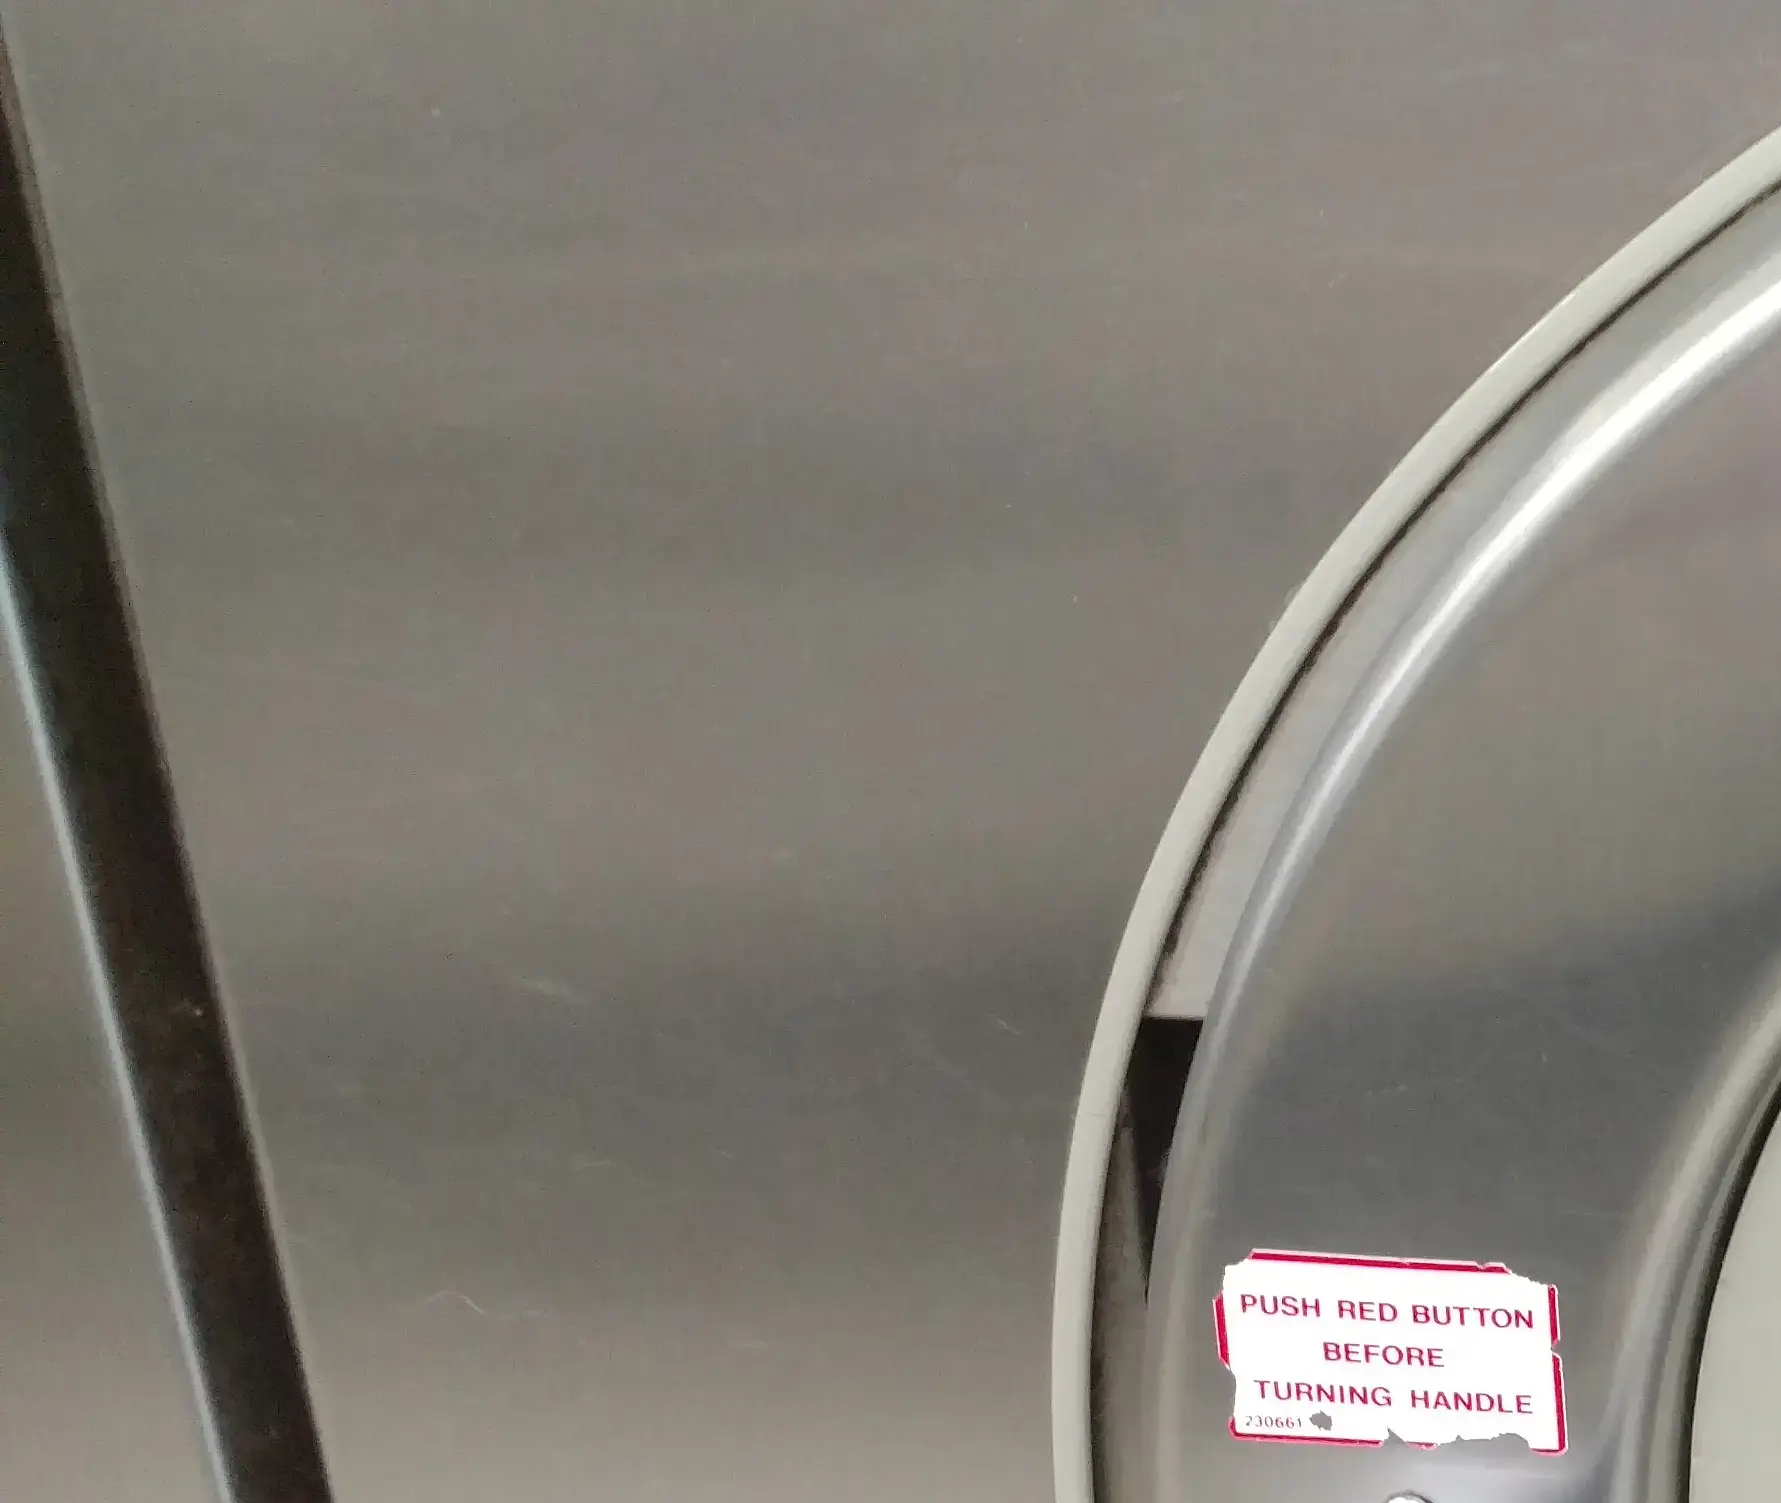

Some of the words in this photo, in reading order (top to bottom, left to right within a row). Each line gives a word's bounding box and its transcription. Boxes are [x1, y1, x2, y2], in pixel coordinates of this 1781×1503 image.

[1240, 1293, 1321, 1318] PUSH
[1337, 1299, 1399, 1323] RED
[1411, 1304, 1534, 1330] BUTTON
[1322, 1341, 1445, 1368] BEFORE
[1253, 1379, 1392, 1407] TURNING
[1410, 1389, 1534, 1415] HANDLE
[1245, 1414, 1303, 1429] 230661
